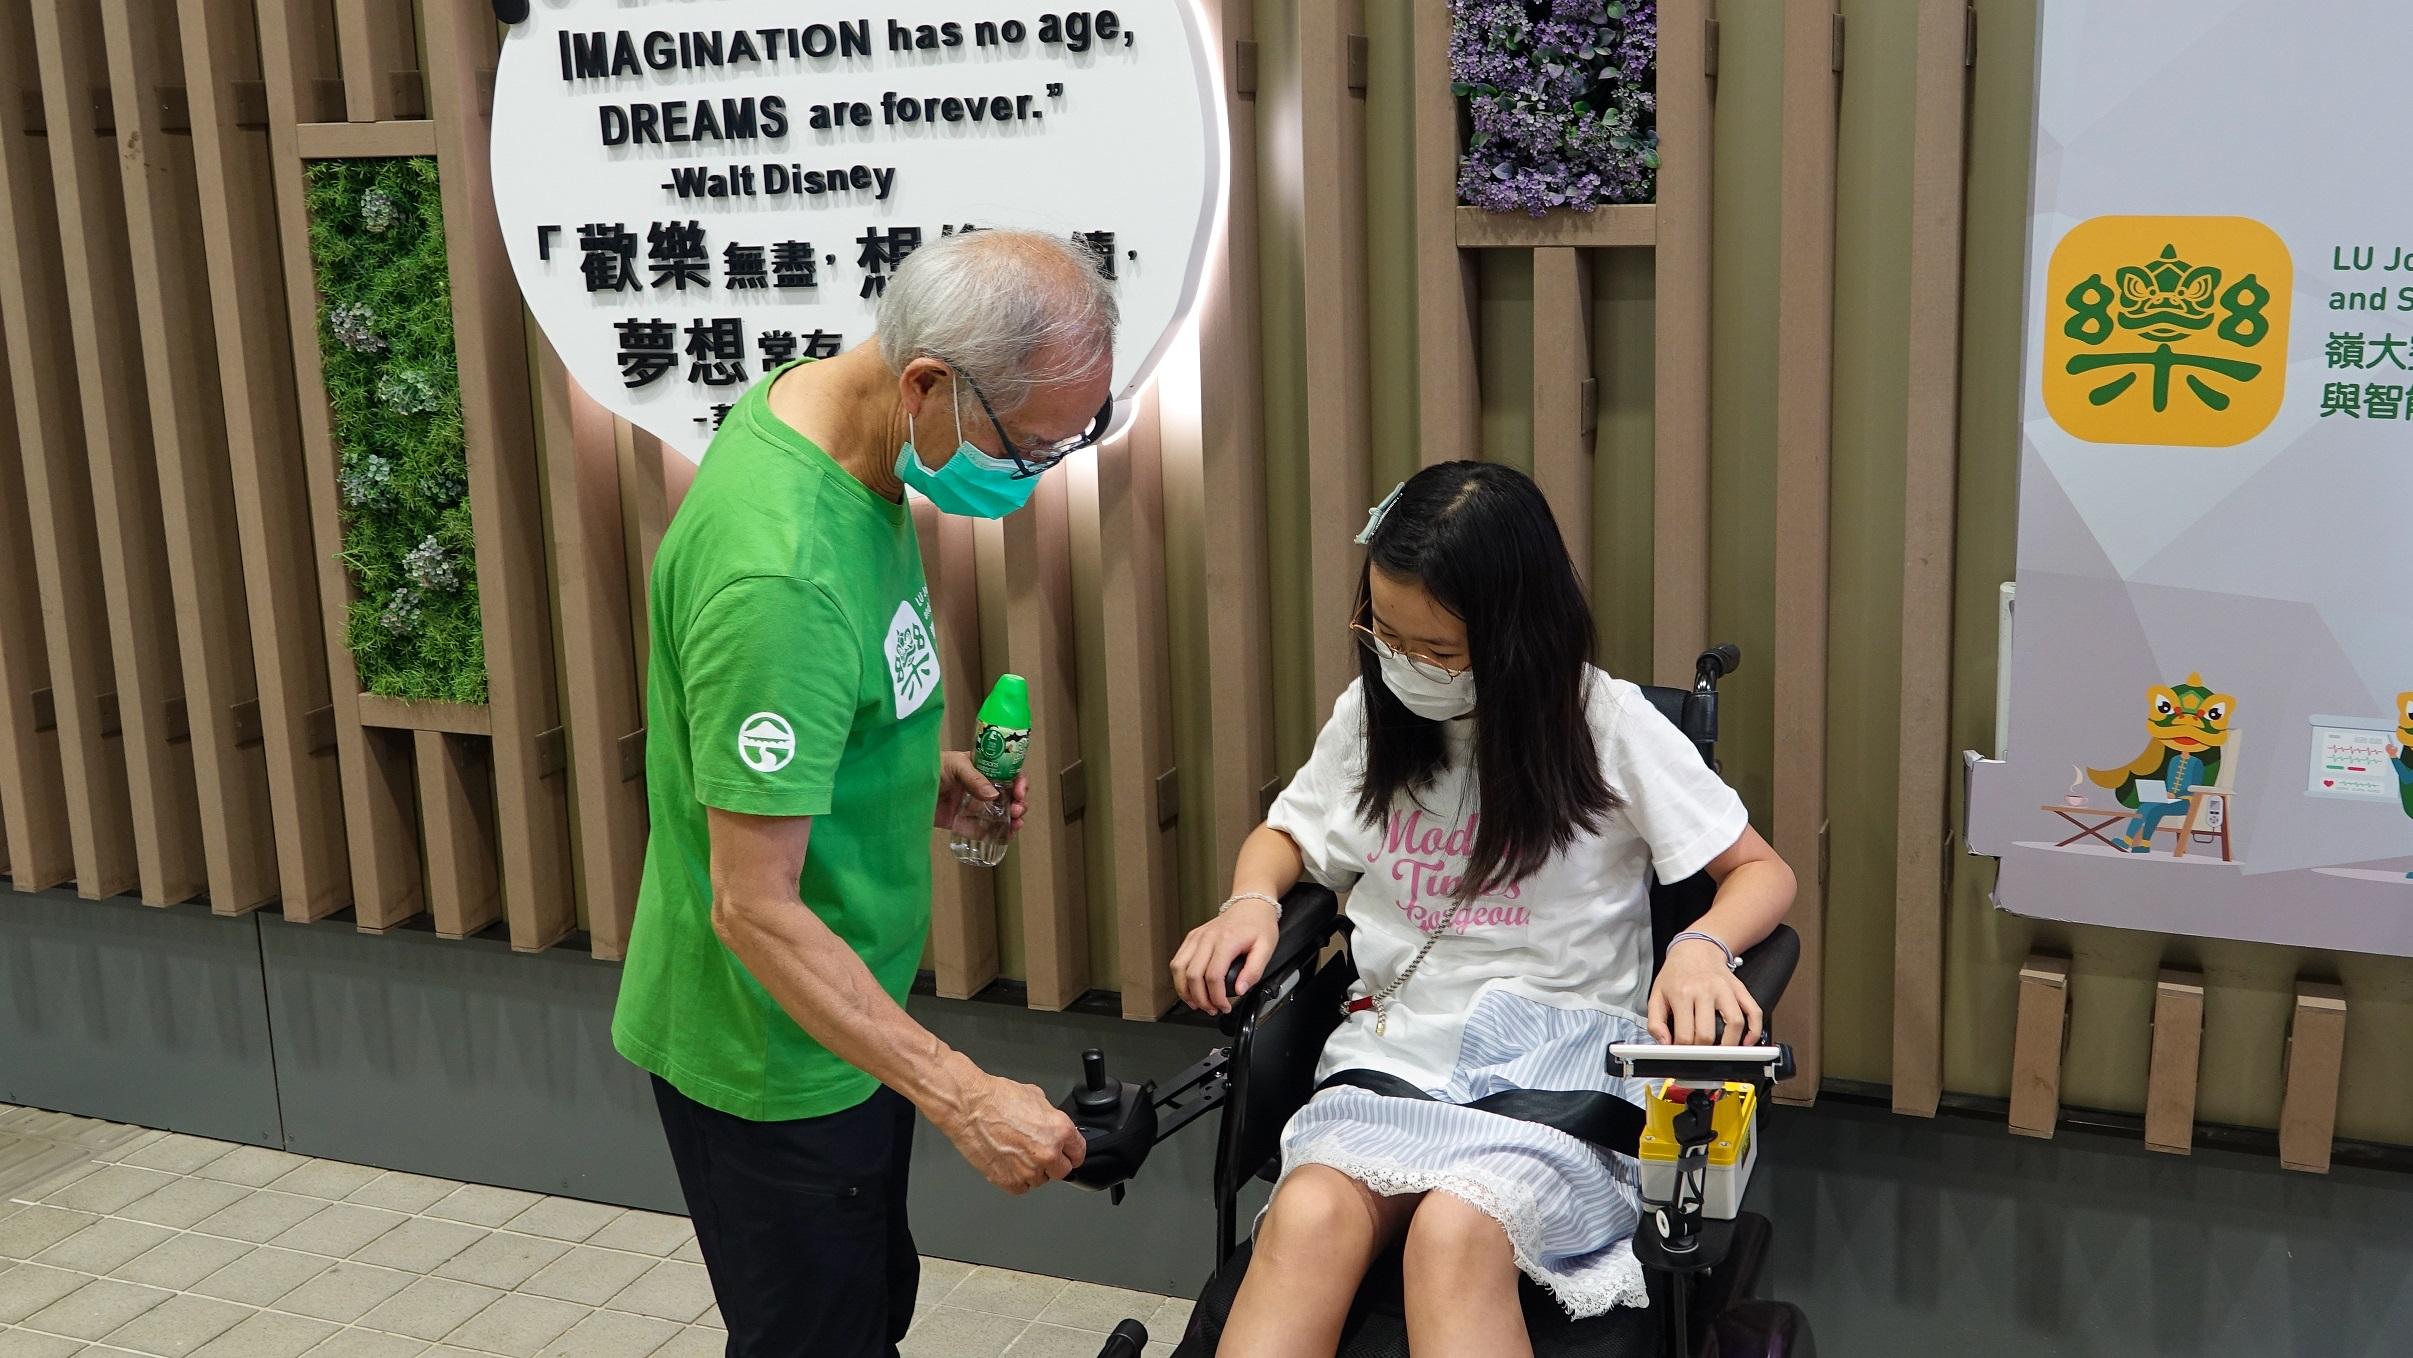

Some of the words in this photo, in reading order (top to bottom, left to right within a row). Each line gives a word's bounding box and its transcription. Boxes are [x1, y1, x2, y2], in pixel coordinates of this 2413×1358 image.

[558, 19, 872, 80] IMAGINATION
[888, 19, 963, 51] has
[975, 19, 1026, 47] no
[1038, 9, 1134, 53] age,
[599, 95, 789, 145] DREAMS
[809, 100, 872, 129] are
[661, 165, 756, 198] -Walt
[763, 164, 895, 200] Disney
[2333, 245, 2374, 272] LU
[2328, 286, 2387, 311] and
[2325, 331, 2413, 370] 嶺大
[2320, 382, 2413, 421] 與智
[1367, 808, 1523, 863] Mod
